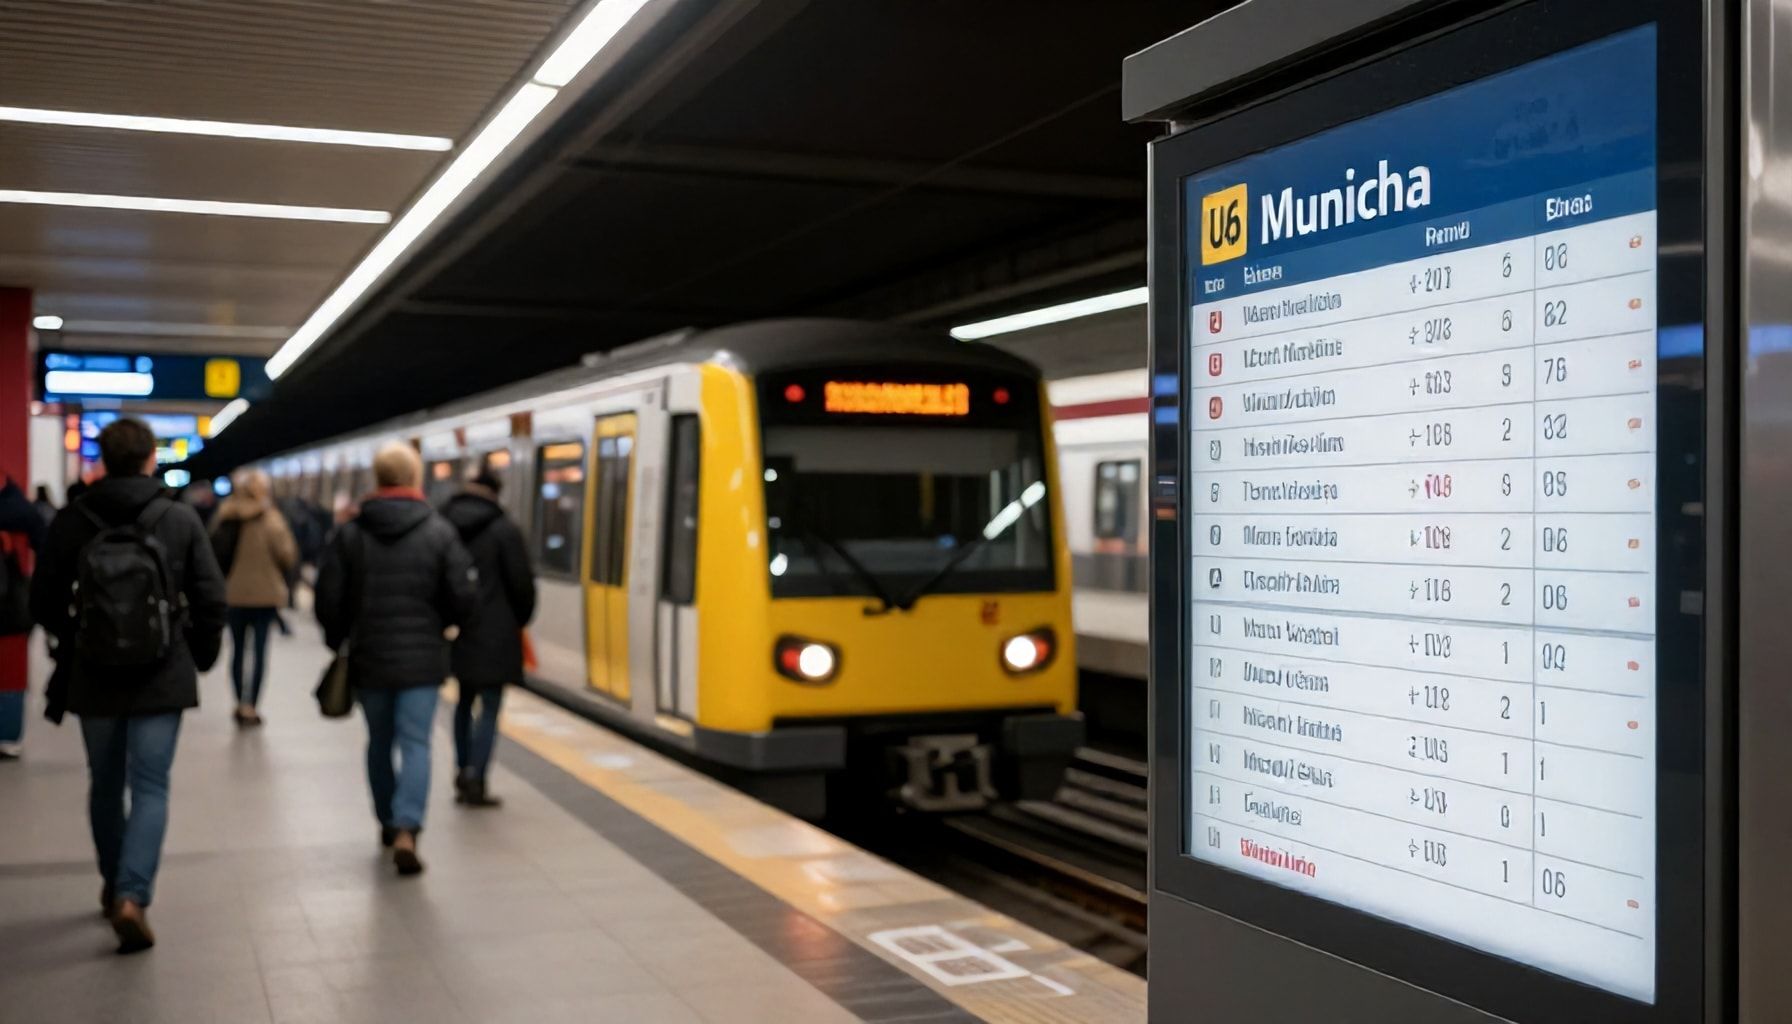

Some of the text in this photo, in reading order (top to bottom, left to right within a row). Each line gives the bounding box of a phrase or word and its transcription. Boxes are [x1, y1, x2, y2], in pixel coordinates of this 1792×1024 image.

[1209, 159, 1431, 249] U6 Municha
[1501, 418, 1512, 441] 2
[1501, 527, 1512, 551] 2
[1500, 583, 1511, 606] 2
[1500, 696, 1511, 720] 2
[1502, 860, 1508, 884] 1
